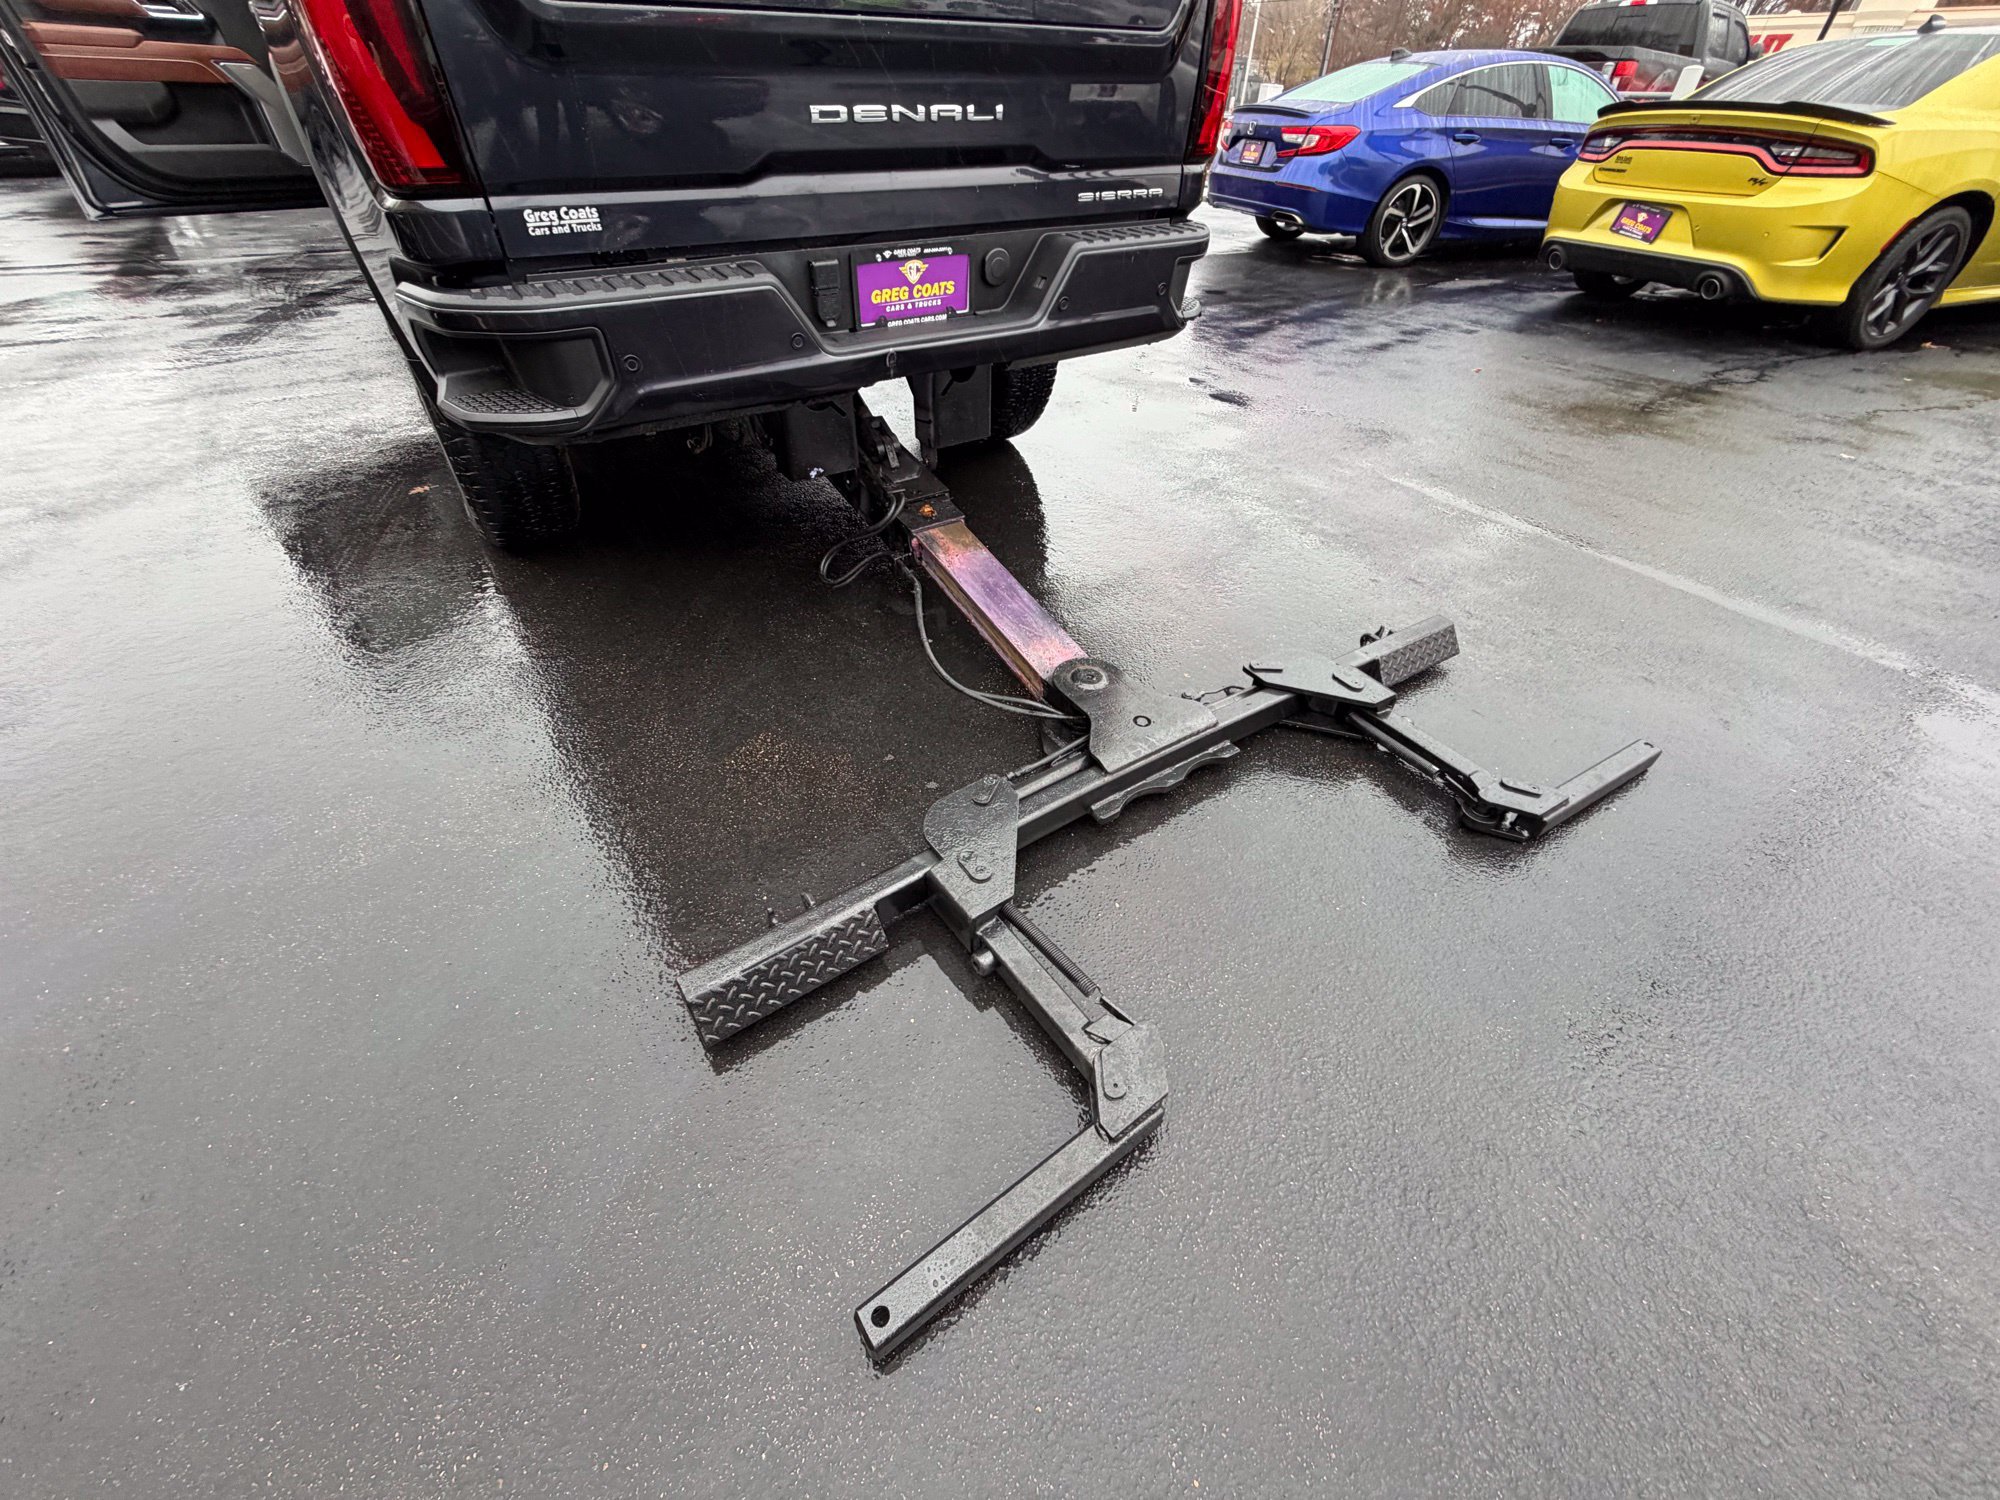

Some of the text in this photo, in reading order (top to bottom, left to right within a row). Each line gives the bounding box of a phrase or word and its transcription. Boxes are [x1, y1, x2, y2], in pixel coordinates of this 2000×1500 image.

[809, 103, 1004, 124] DENALI
[1077, 188, 1164, 202] SIERRA
[523, 206, 599, 226] Greg Coats
[528, 222, 603, 236] Cars and Trucks
[871, 280, 955, 304] GREG COATS
[886, 299, 942, 312] CARS & TRUCKS
[887, 314, 947, 327] GREG COATS CARS.COM
